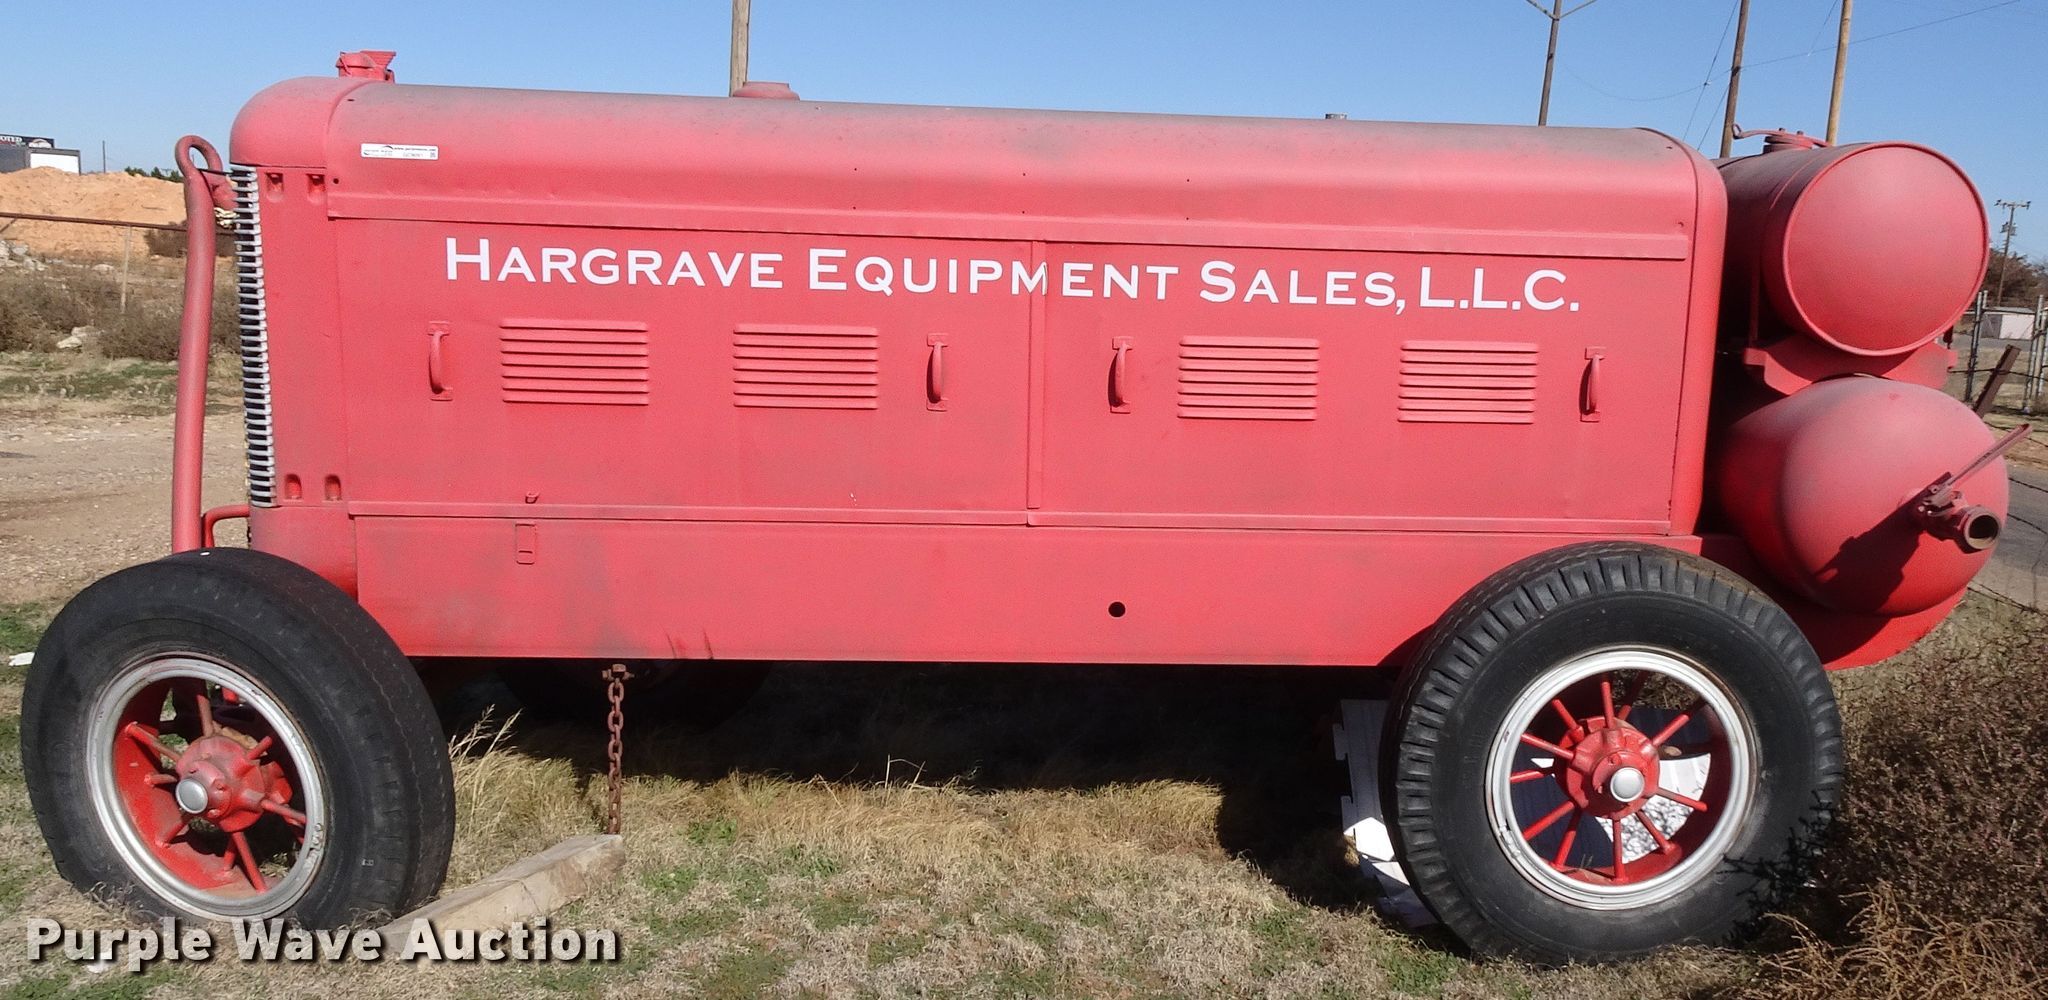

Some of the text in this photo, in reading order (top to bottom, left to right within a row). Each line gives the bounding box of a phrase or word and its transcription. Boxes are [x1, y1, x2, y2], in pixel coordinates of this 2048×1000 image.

[447, 238, 1580, 315] HARGRAVE EQUIPMENT SALES, L.L.C.
